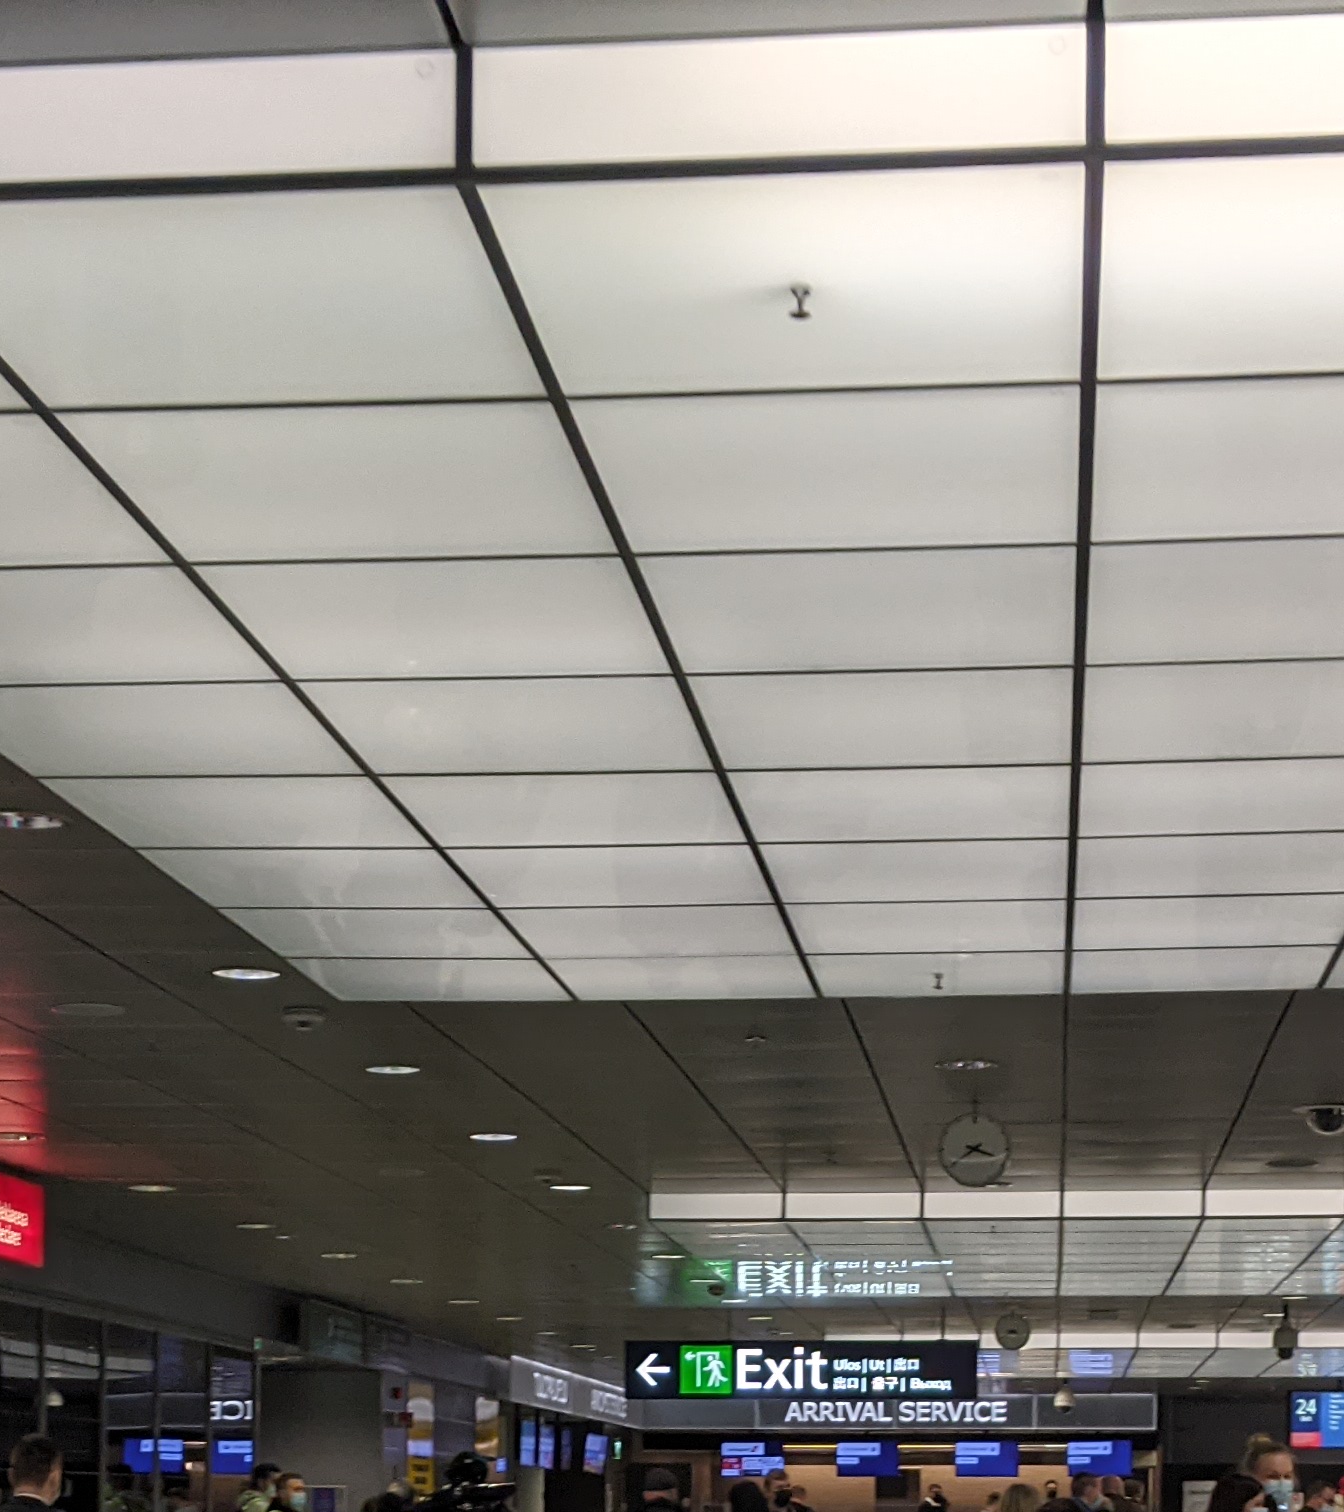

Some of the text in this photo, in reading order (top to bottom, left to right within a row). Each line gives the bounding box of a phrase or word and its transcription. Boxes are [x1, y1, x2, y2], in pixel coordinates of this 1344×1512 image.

[735, 1346, 828, 1390] Exit
[784, 1401, 1007, 1422] ARRIVAL SERVICE
[1295, 1398, 1317, 1414] 24
